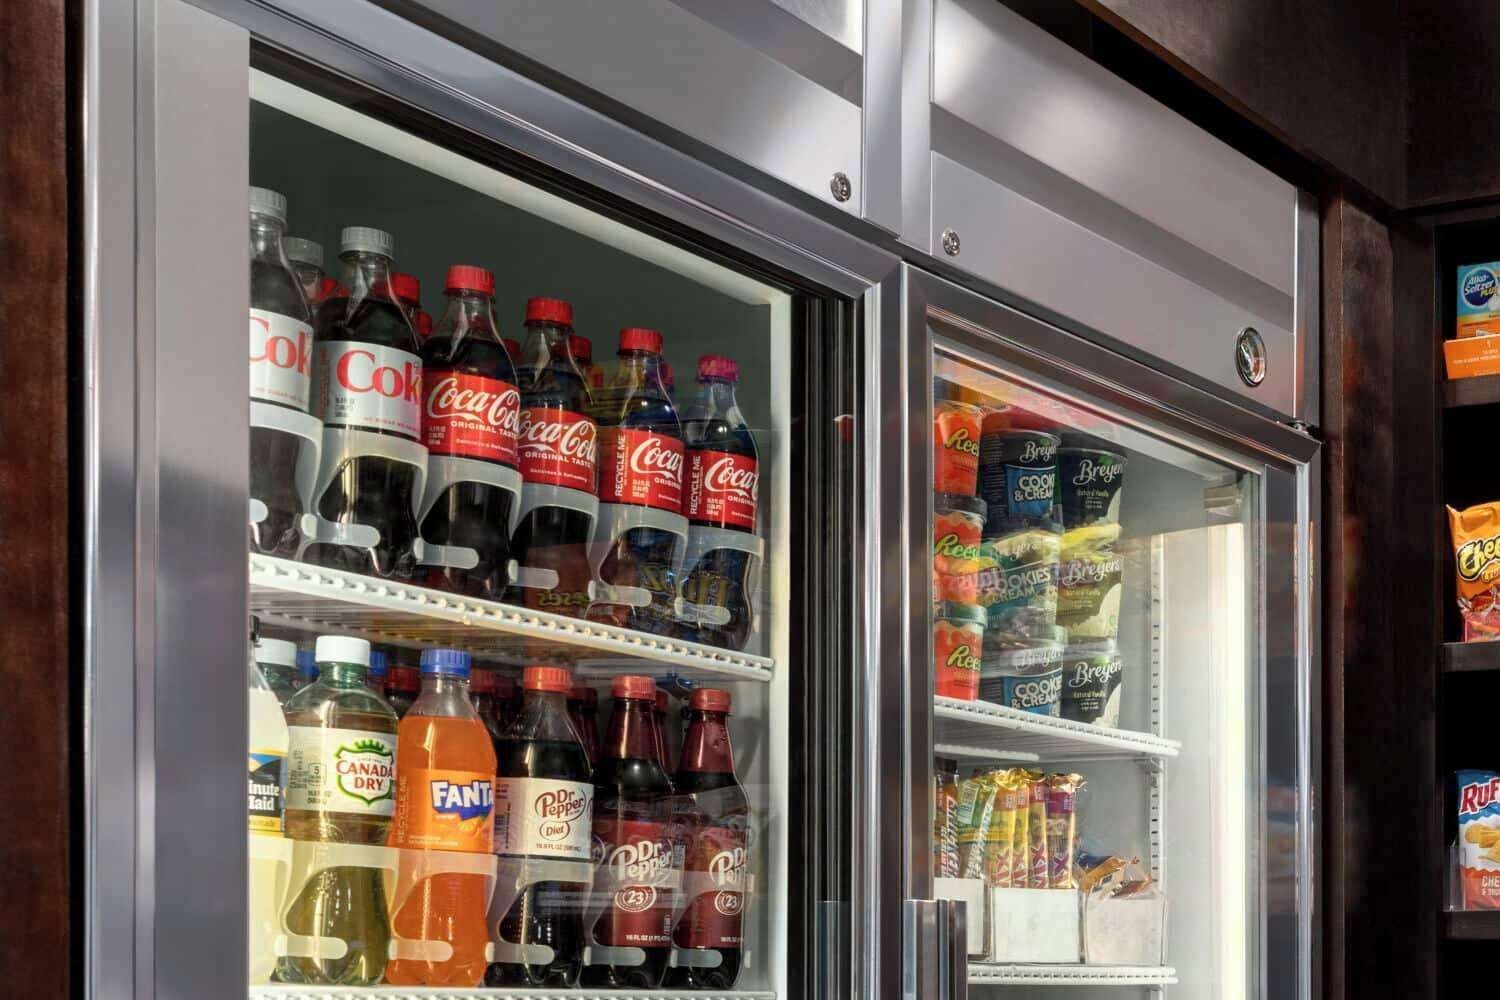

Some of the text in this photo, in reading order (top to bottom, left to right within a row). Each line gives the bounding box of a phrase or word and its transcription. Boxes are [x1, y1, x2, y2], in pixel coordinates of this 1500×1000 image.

[427, 378, 520, 432] Coca-Col
[519, 410, 597, 464] Coca-Col
[525, 451, 591, 468] ORIGINAL TASTE
[1073, 459, 1124, 485] Breyer
[1069, 661, 1122, 688] Breyer
[336, 759, 393, 778] CANADA
[249, 780, 280, 796] inute
[354, 777, 384, 792] DRY
[429, 780, 493, 809] FANT
[536, 790, 585, 818] Pepper
[556, 789, 576, 805] Dr
[545, 824, 565, 837] Diet
[639, 840, 661, 860] Dr
[615, 845, 673, 882] Pepper
[628, 890, 644, 904] 23
[725, 894, 737, 908] 23
